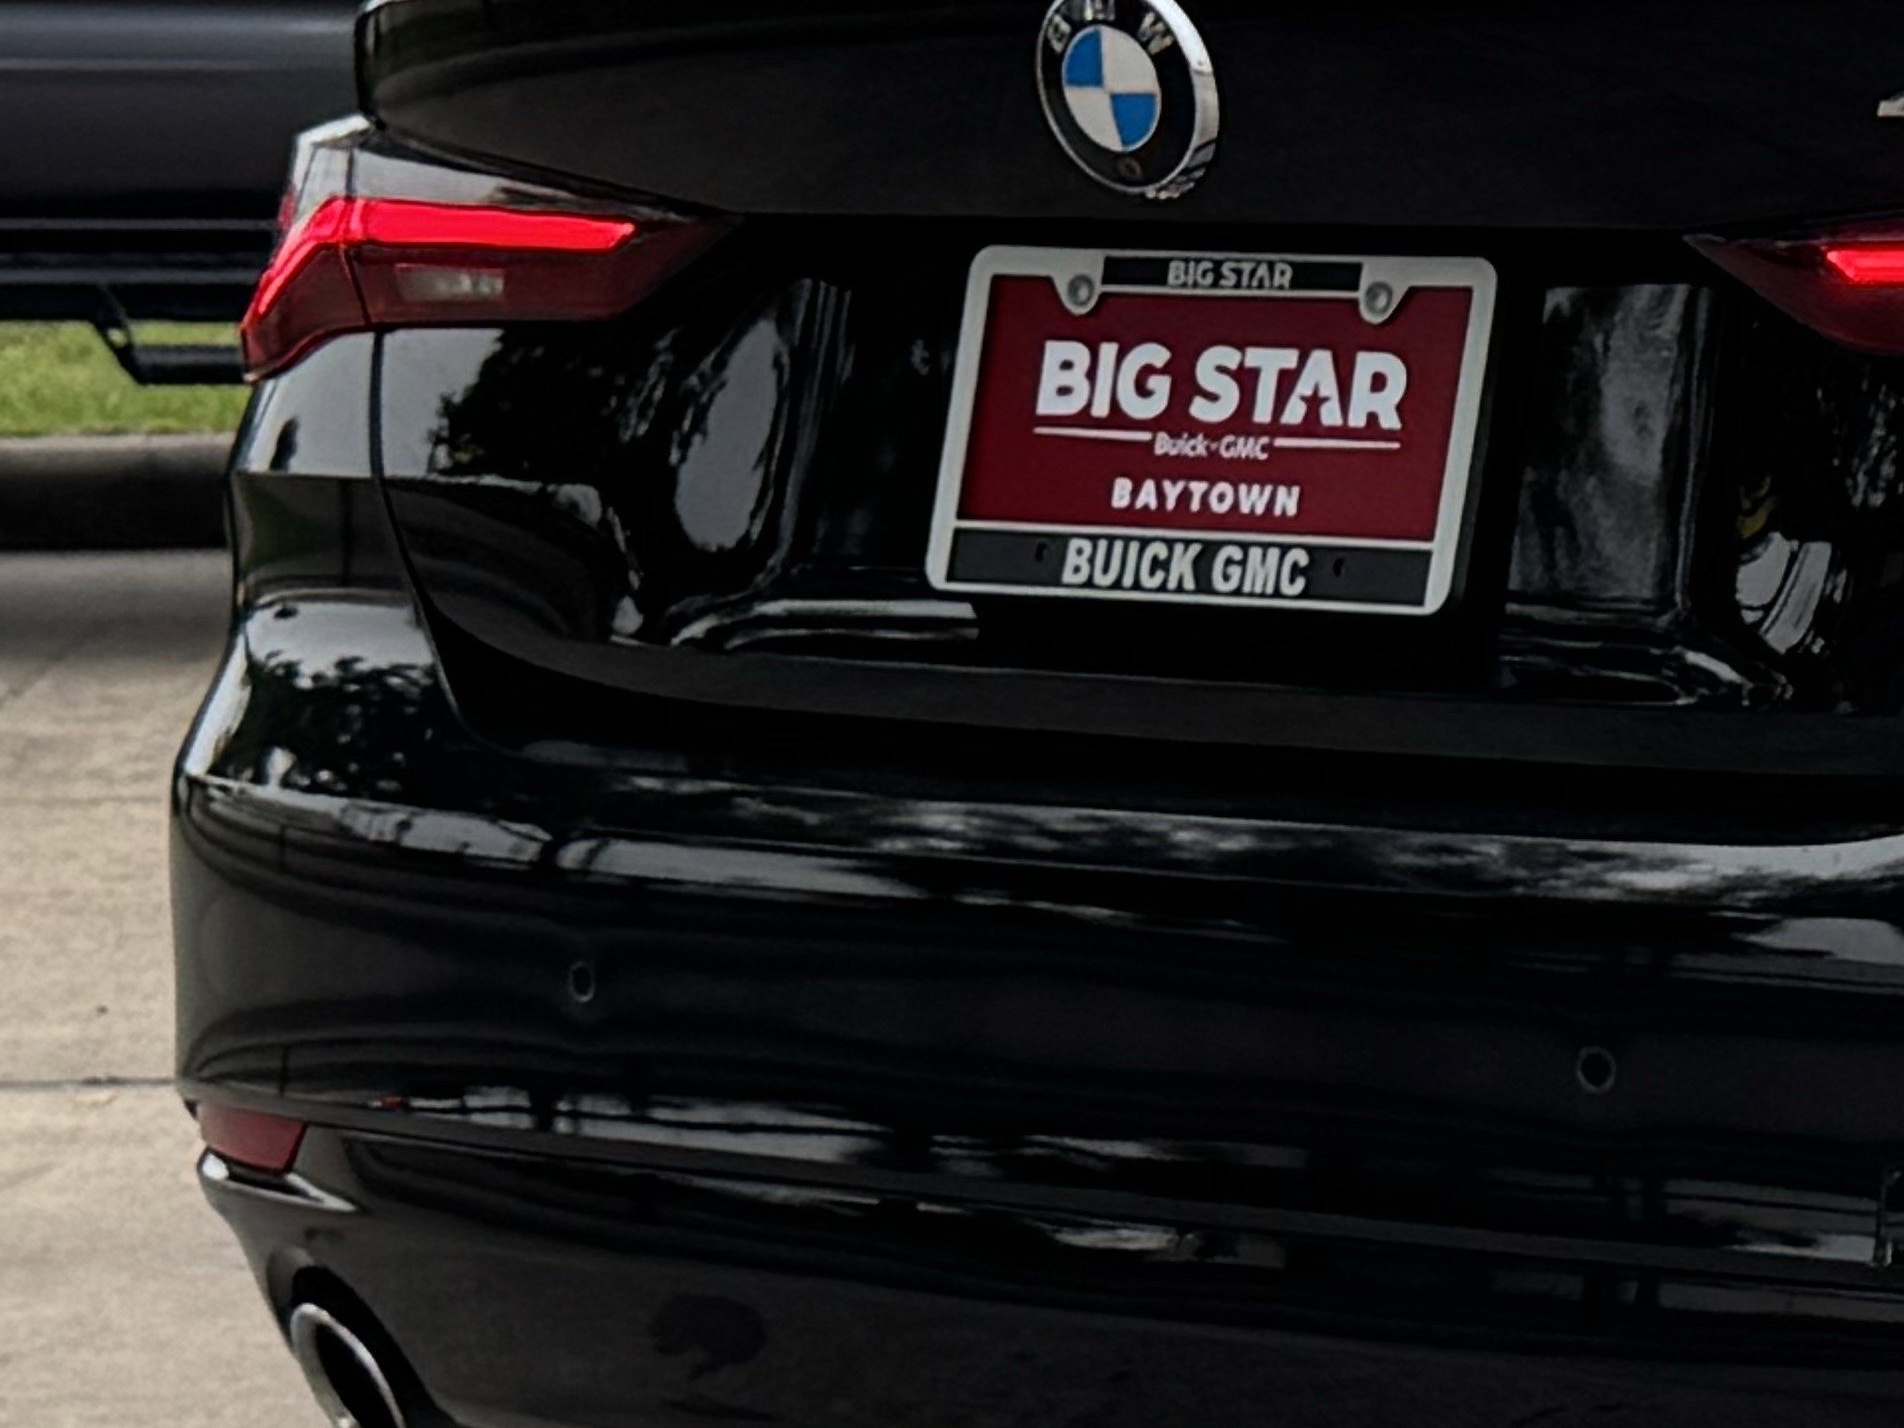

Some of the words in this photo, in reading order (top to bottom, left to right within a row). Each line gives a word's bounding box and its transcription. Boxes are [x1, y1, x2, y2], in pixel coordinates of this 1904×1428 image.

[1167, 260, 1214, 286] BIG
[1219, 262, 1293, 289] STAR
[1035, 340, 1172, 420] BIG
[1188, 345, 1407, 430] STAR
[1111, 477, 1300, 517] BAYTOWN
[1060, 537, 1202, 592] BUICK
[1211, 545, 1311, 595] GMC
